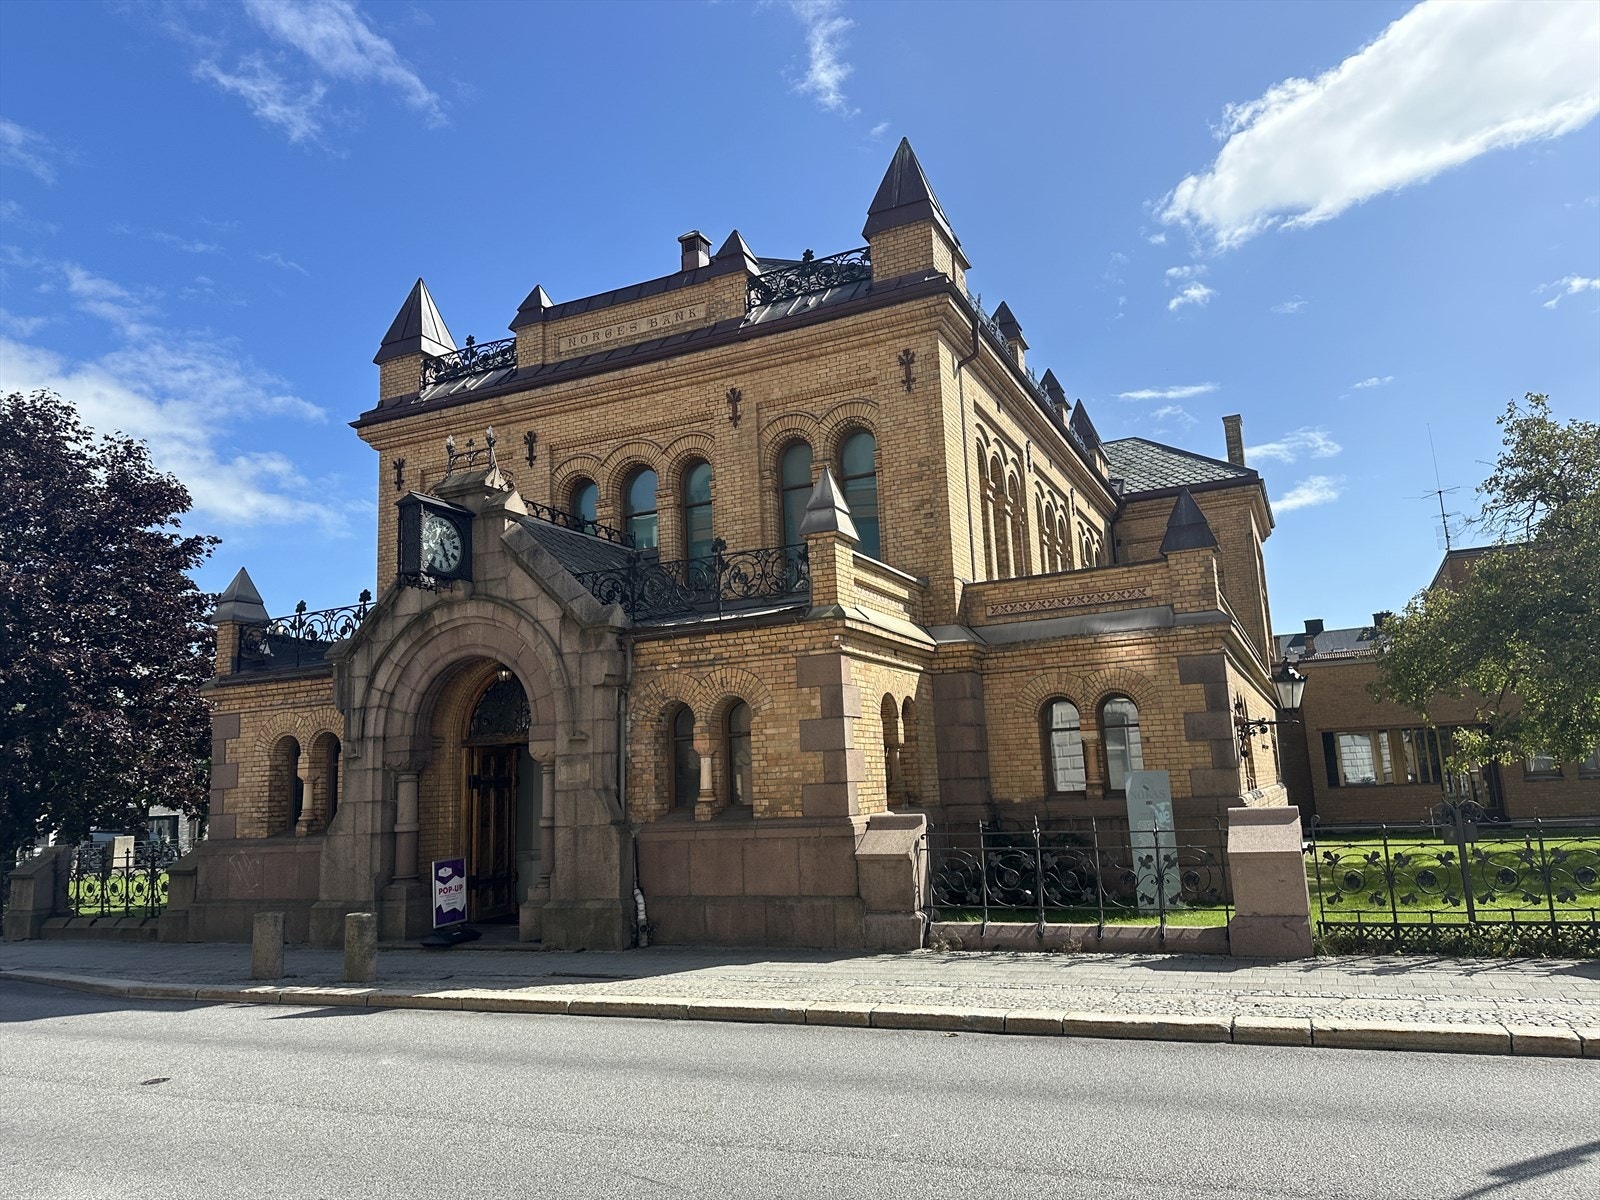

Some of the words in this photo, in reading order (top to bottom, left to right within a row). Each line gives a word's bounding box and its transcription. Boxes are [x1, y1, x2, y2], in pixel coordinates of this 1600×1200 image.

[567, 322, 638, 347] NORGES
[650, 307, 697, 328] BANK
[1131, 790, 1166, 800] NOKAS
[438, 884, 463, 895] POP-UP
